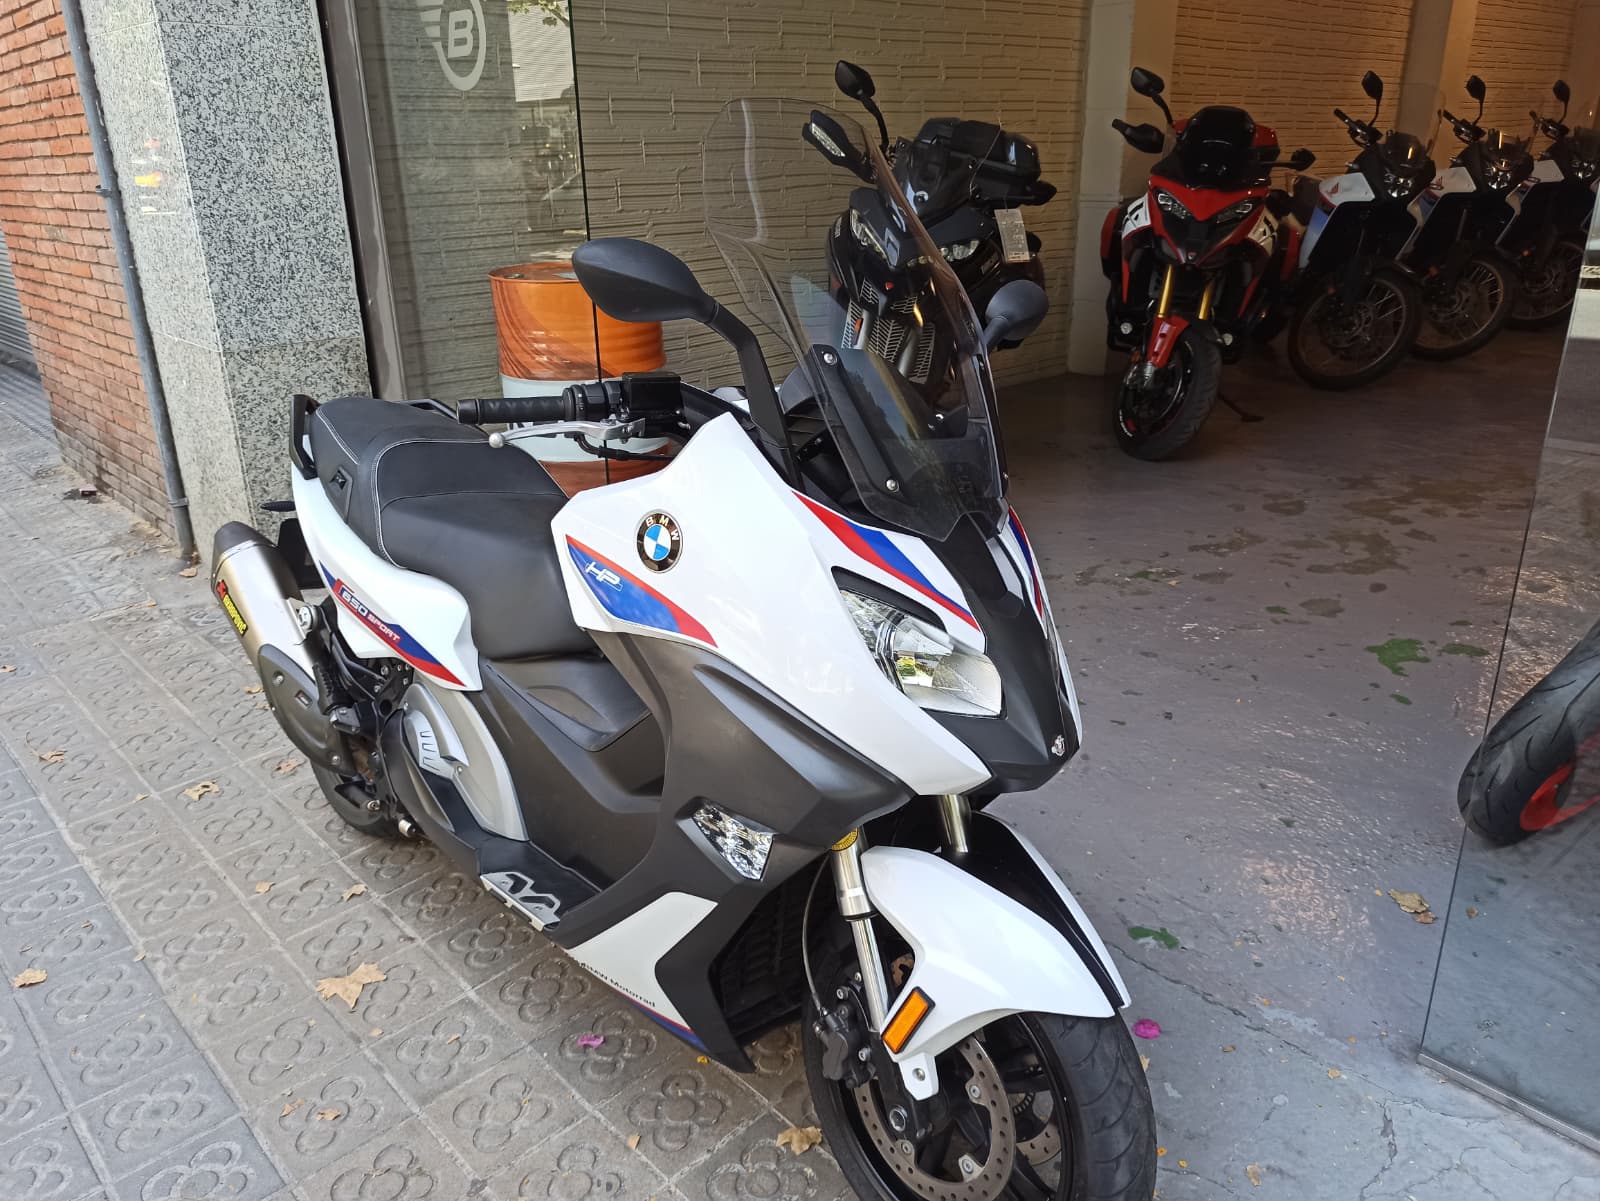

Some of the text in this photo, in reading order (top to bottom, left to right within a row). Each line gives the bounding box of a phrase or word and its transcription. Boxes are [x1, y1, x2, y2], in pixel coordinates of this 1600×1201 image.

[448, 9, 473, 58] B
[645, 515, 680, 541] BMW
[585, 561, 621, 586] HP
[367, 613, 400, 641] SPORT
[609, 978, 656, 1008] Motorrad
